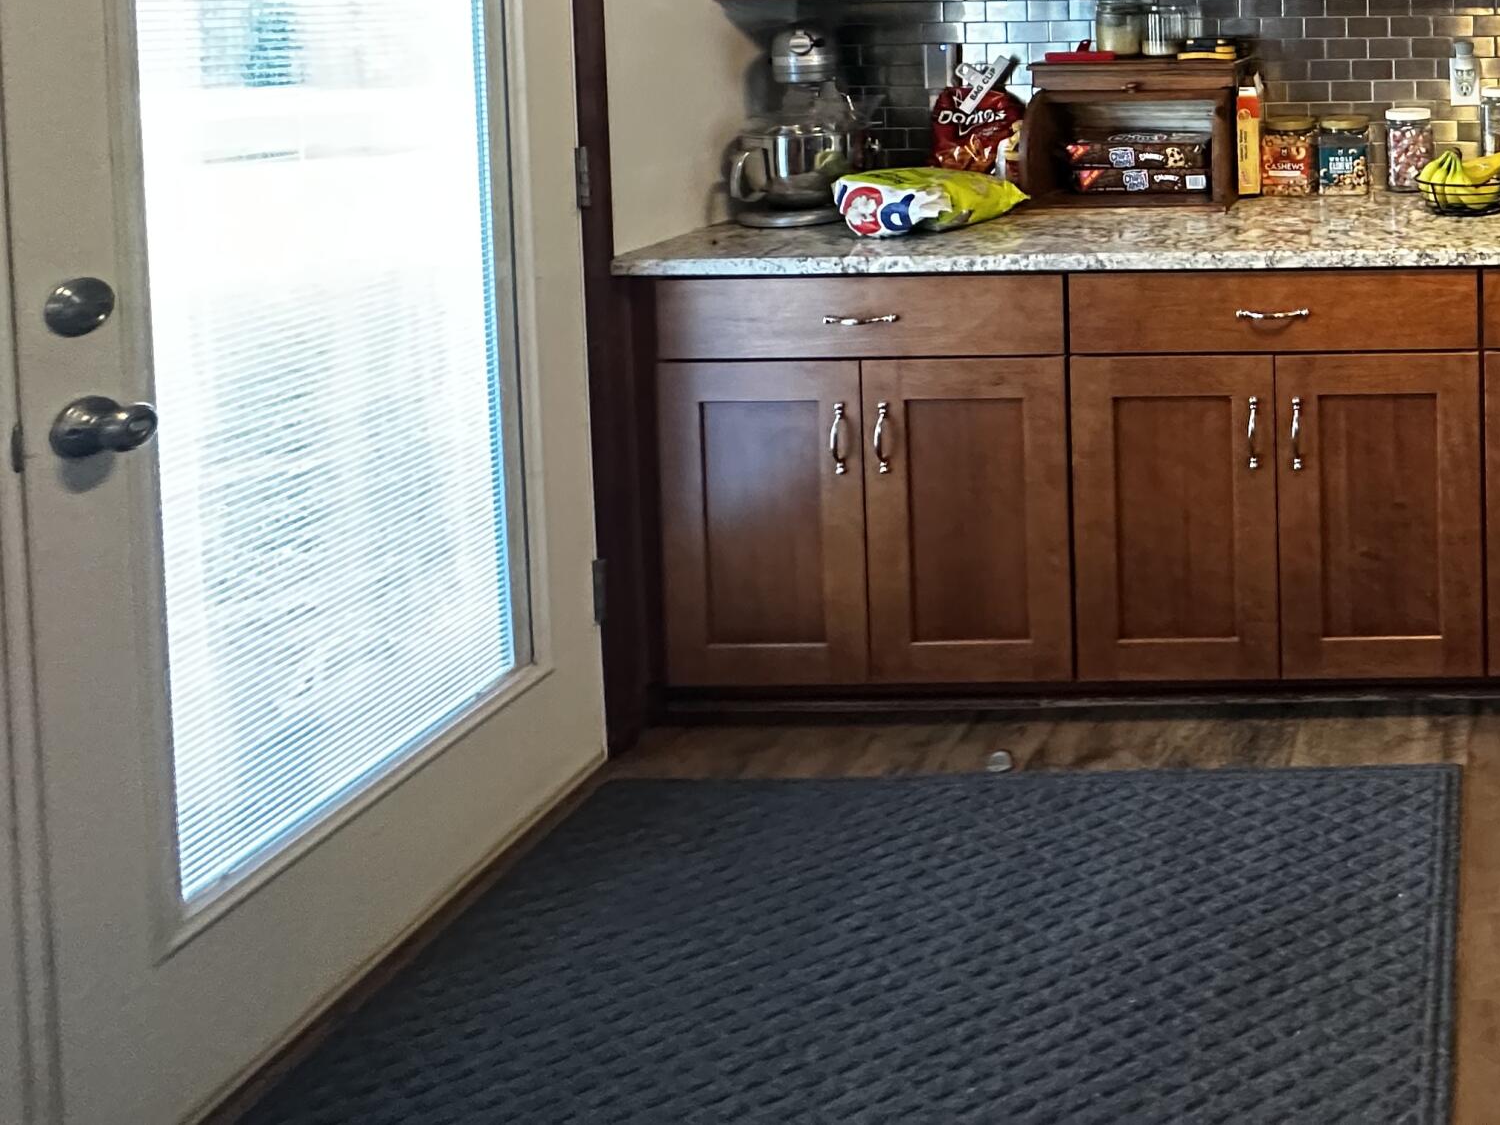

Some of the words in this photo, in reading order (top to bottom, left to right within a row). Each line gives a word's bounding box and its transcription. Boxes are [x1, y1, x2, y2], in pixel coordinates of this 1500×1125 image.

[969, 84, 984, 101] BAG
[982, 67, 996, 85] CLIP
[938, 109, 1007, 125] Doritos
[1264, 162, 1305, 171] CASHEWS
